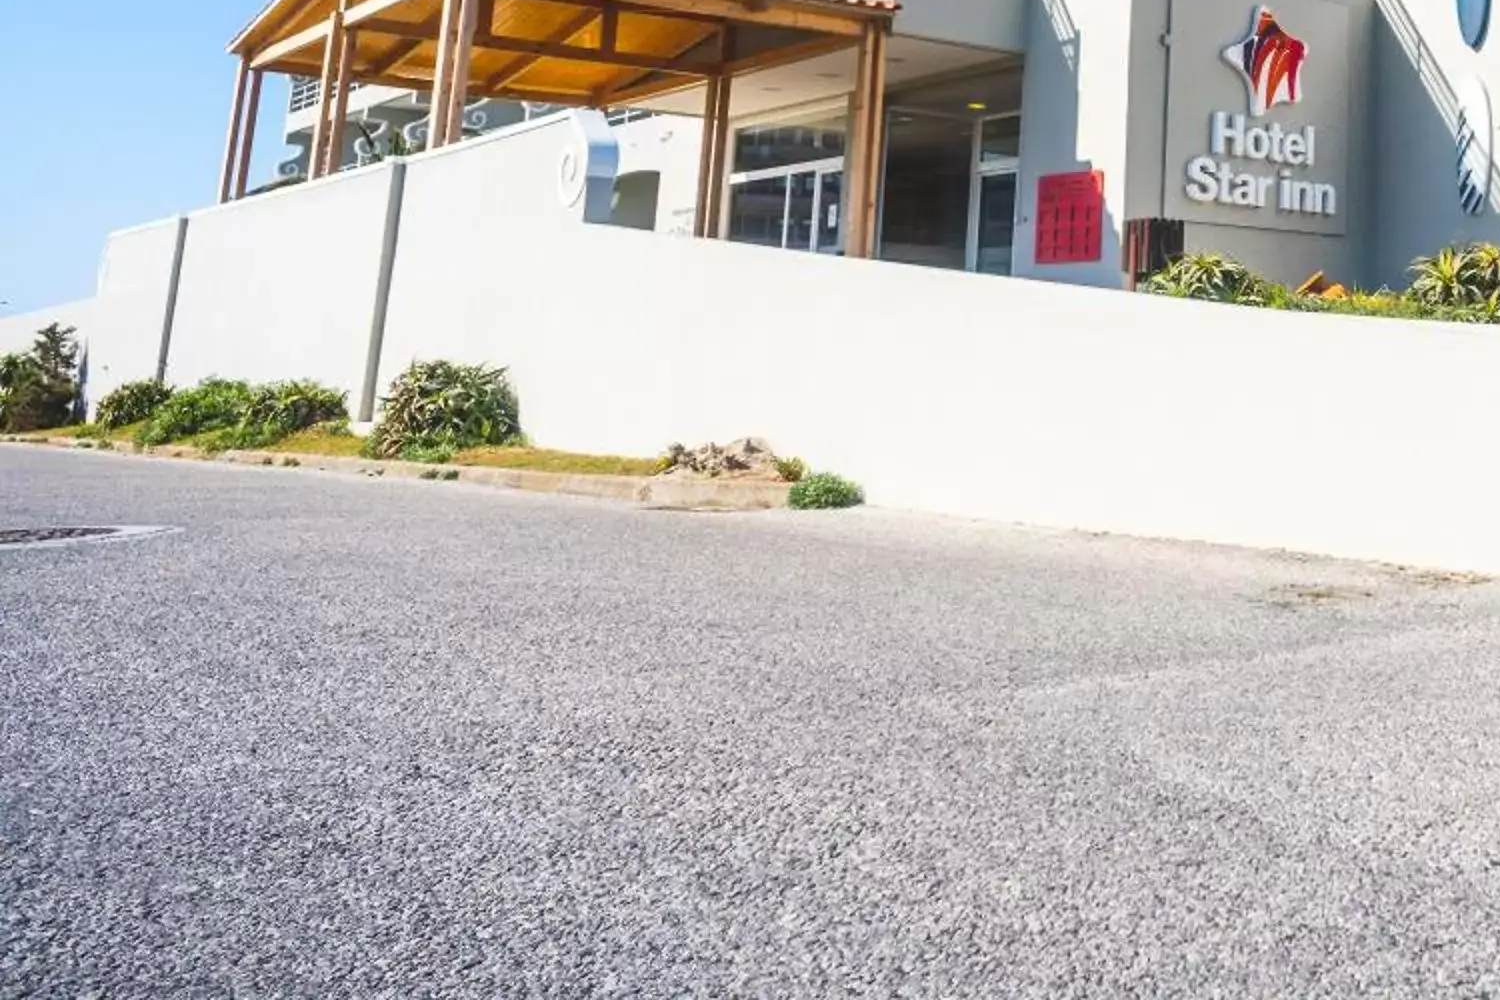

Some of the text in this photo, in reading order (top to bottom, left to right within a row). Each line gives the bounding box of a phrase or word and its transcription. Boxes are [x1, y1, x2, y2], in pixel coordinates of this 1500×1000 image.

[1211, 111, 1315, 166] Hotel
[1185, 156, 1336, 215] Star inn
